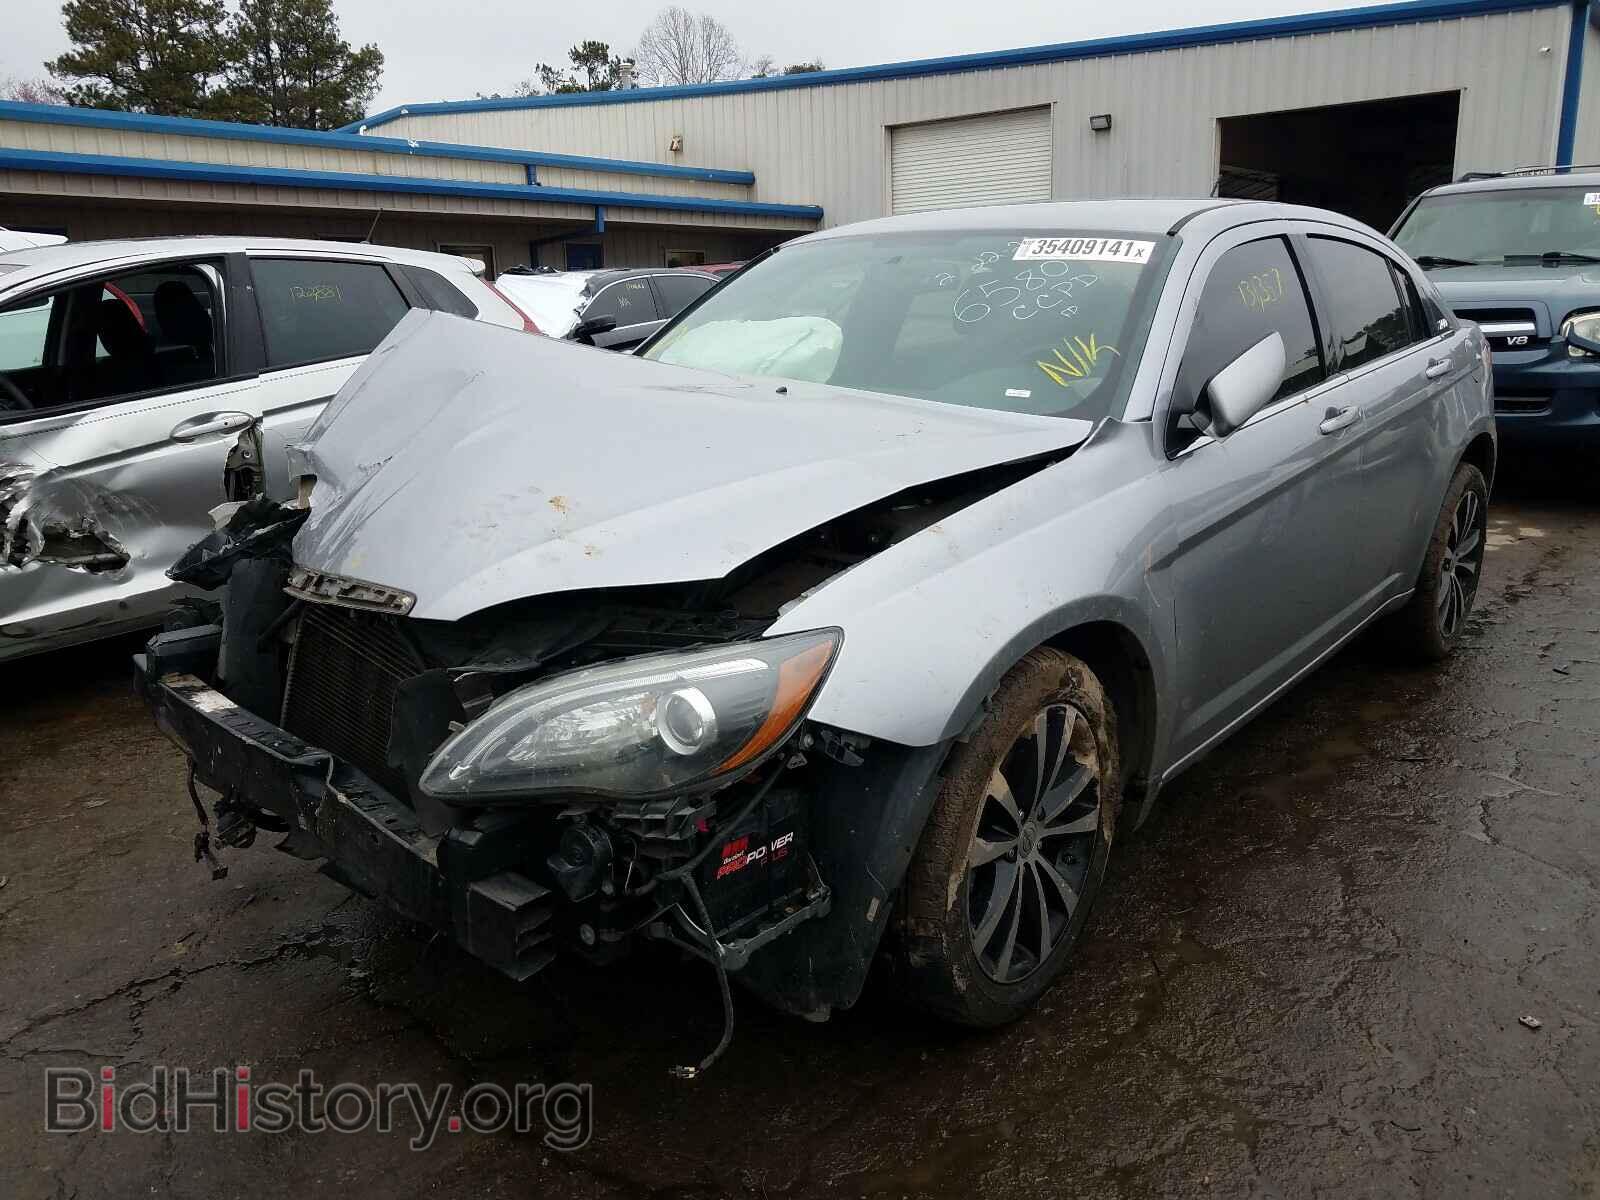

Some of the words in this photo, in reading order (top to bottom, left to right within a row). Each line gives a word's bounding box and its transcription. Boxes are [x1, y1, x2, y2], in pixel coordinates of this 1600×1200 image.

[1031, 239, 1134, 257] 35409141
[953, 260, 1069, 323] 6580
[1506, 335, 1529, 346] V8
